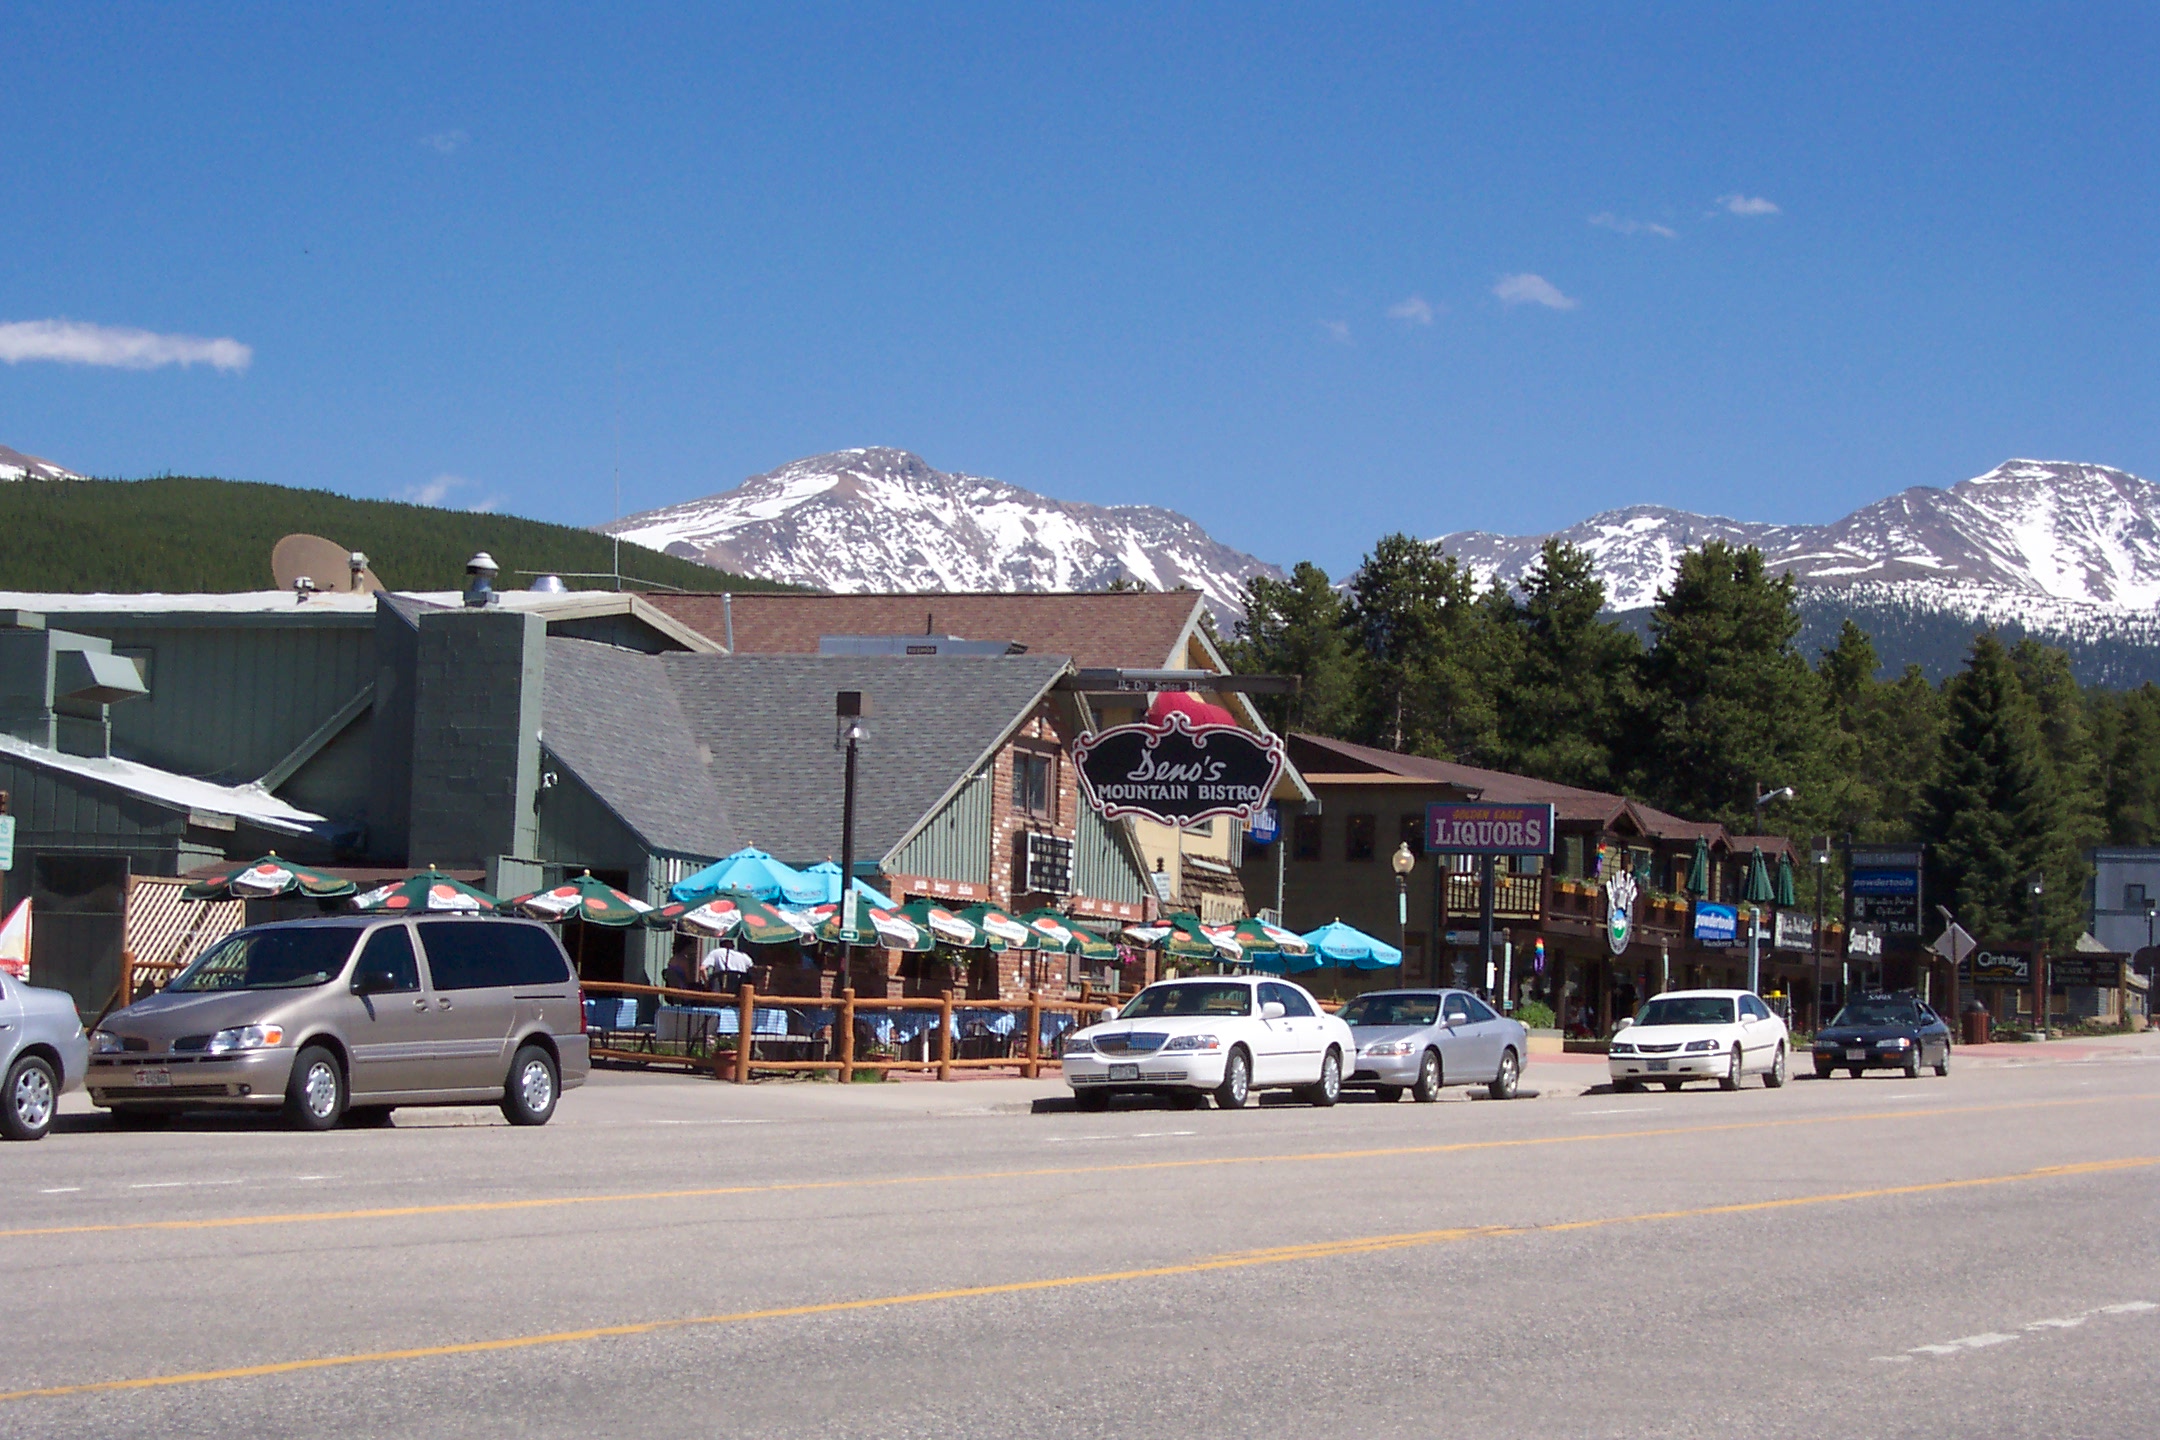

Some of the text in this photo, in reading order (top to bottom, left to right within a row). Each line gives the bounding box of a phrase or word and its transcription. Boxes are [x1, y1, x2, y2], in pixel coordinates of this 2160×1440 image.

[1127, 749, 1227, 781] Deno's
[1098, 785, 1261, 800] MOUNTAIN BISTRO
[1435, 819, 1541, 846] LIQUORS
[1977, 951, 2020, 967] Century
